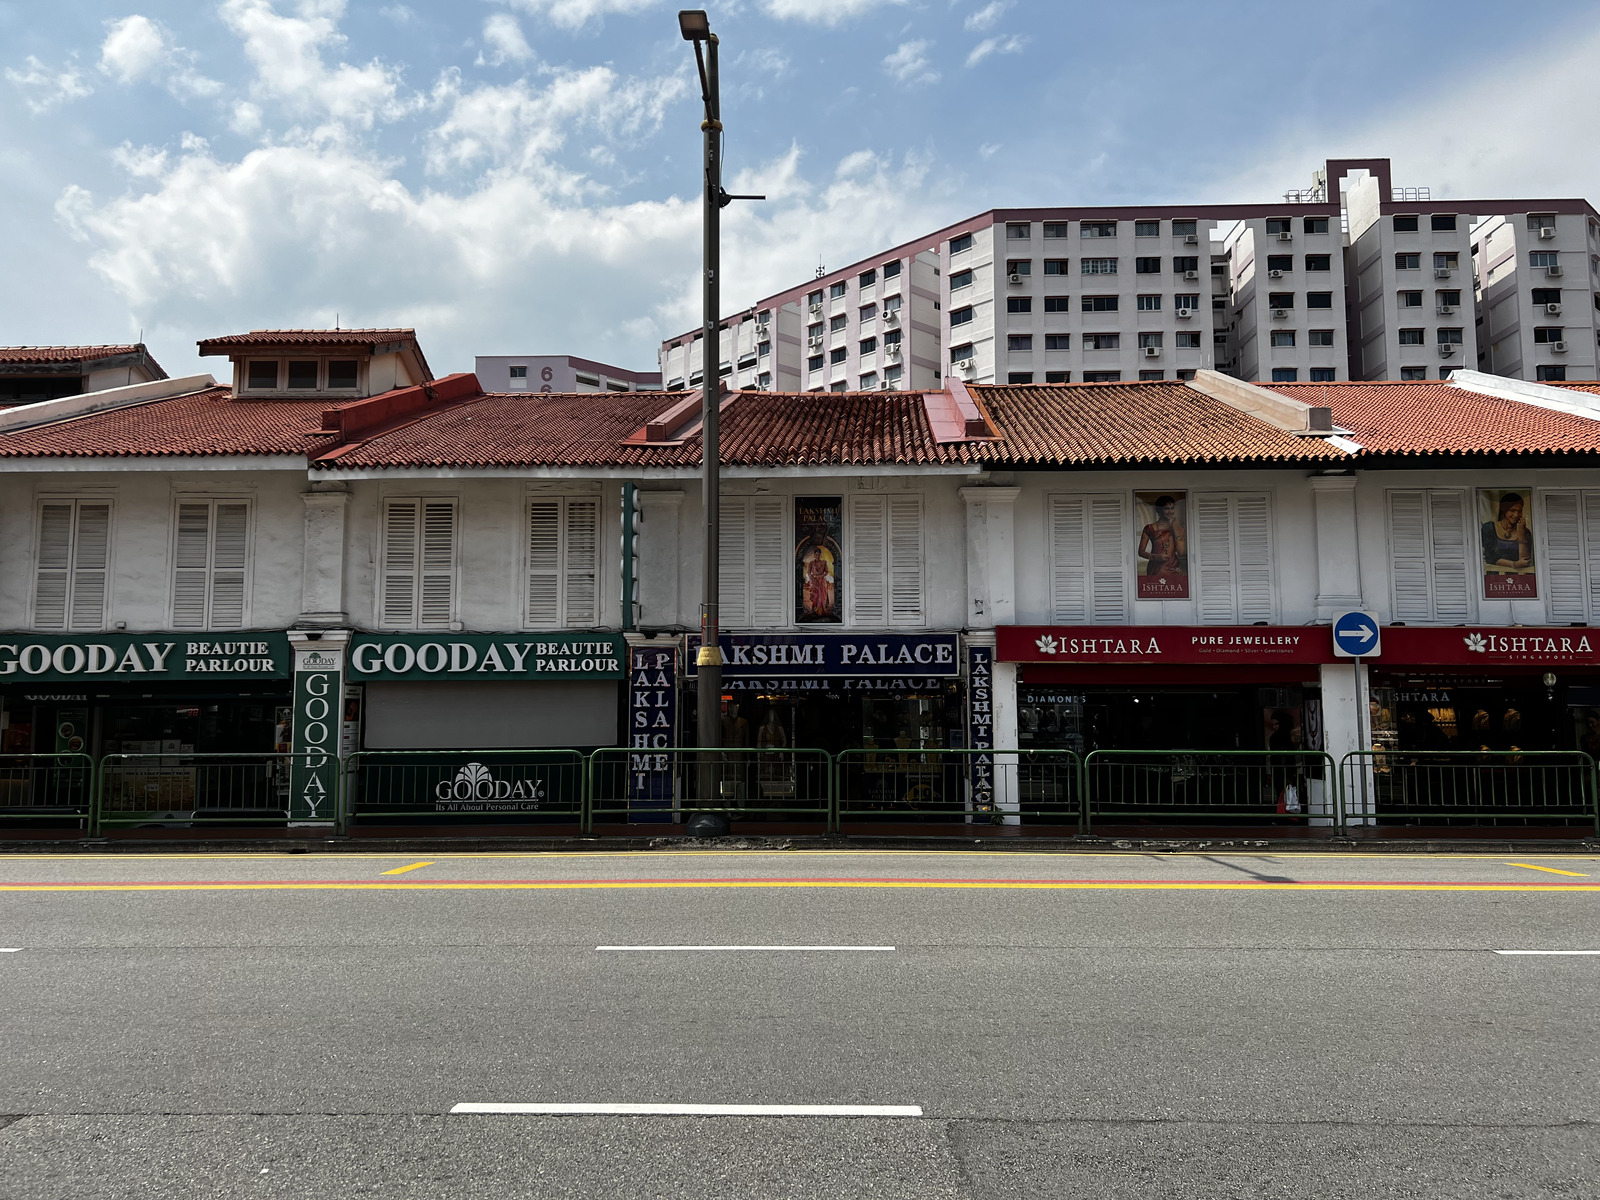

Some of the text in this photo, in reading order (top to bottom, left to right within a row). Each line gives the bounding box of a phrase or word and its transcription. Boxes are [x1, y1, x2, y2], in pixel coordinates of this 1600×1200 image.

[799, 507, 839, 515] LAKSHMI
[1142, 583, 1183, 592] ISHTARA
[1489, 583, 1531, 592] ISHTARA
[1059, 636, 1162, 655] ISHTARA
[1191, 636, 1300, 645] PURE JEWELLERY
[1488, 635, 1593, 654] ISHTARA
[186, 642, 270, 655] BEAUTIE
[536, 642, 613, 656] BEAUTIE
[840, 644, 953, 665] PALACE
[302, 657, 336, 665] GOODAY
[351, 642, 536, 674] GOODAY
[535, 658, 619, 672] PARLOUR
[185, 659, 275, 672] PARLOUR
[972, 653, 992, 737] LAKSHMI
[1027, 695, 1087, 703] DIAMONDS
[652, 653, 671, 772] PALACE
[632, 653, 652, 790] LAKSHMI
[304, 673, 330, 818] GOODAY
[435, 779, 543, 800] GOODAY
[447, 803, 459, 811] All
[460, 803, 484, 811] About
[486, 802, 519, 811] Personal
[520, 802, 539, 810] Care
